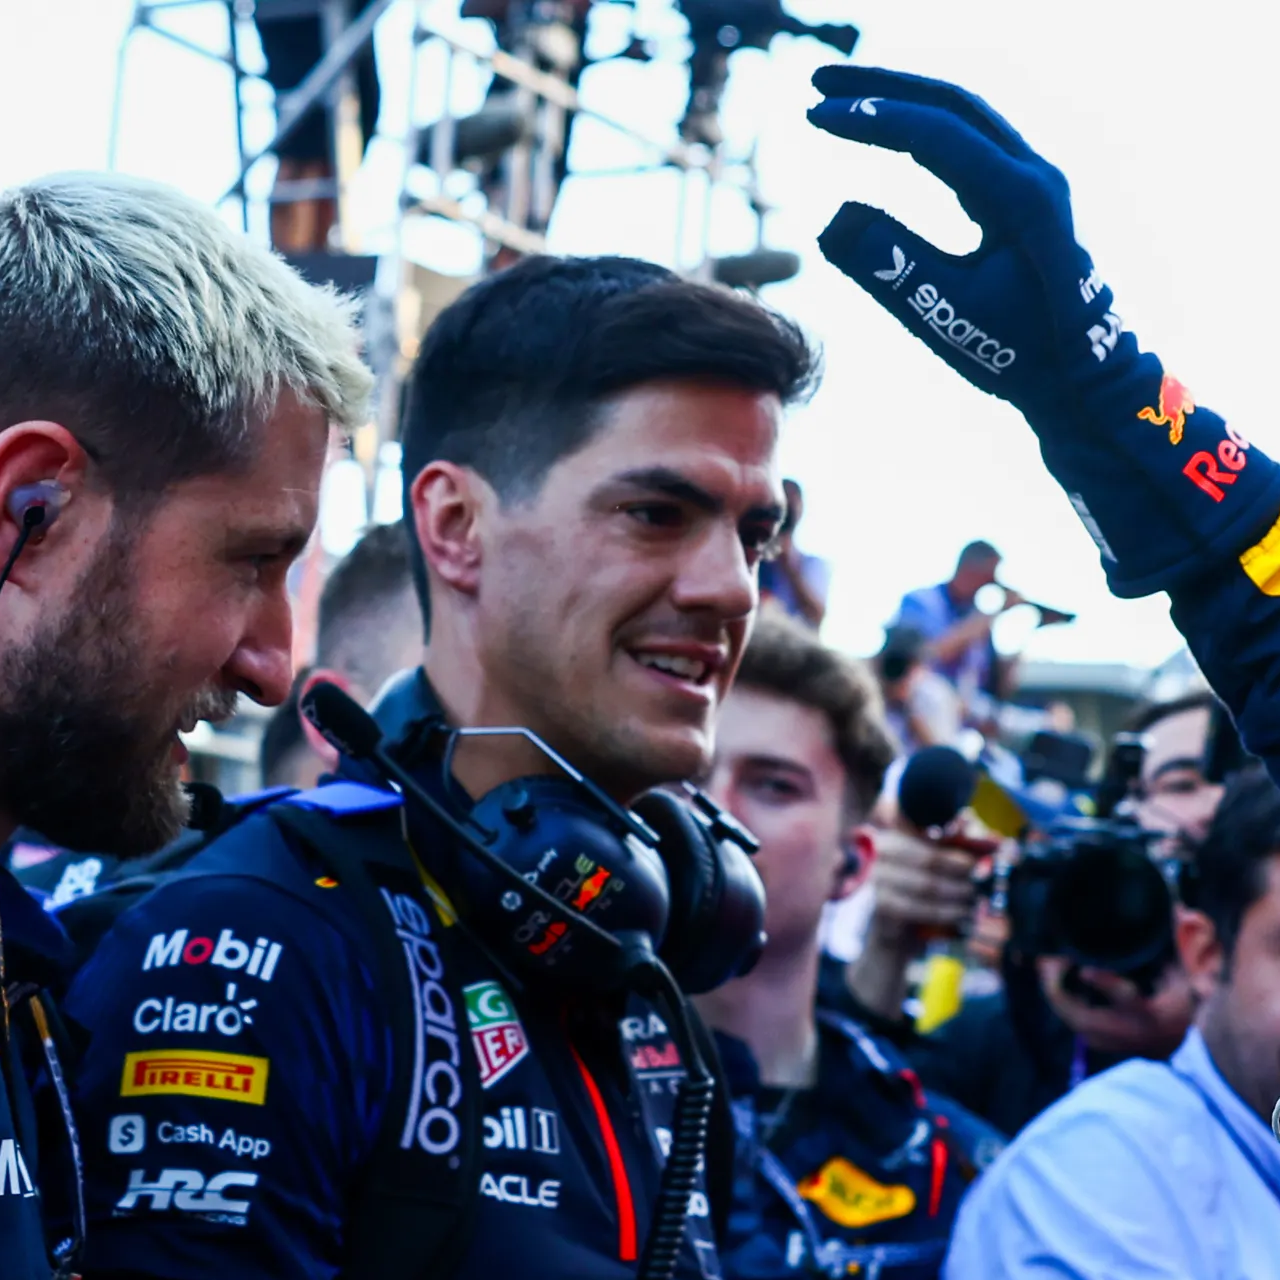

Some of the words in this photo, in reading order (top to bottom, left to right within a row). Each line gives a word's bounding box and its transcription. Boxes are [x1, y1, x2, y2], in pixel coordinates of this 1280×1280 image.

[914, 283, 1017, 370] sparco
[142, 929, 283, 982] Mobil
[393, 893, 462, 1154] sparco
[133, 1058, 256, 1095] PIRELLI
[157, 1122, 214, 1147] Cash
[221, 1129, 271, 1159] App
[115, 1169, 259, 1214] HRC
[479, 1172, 562, 1209] ACLE
